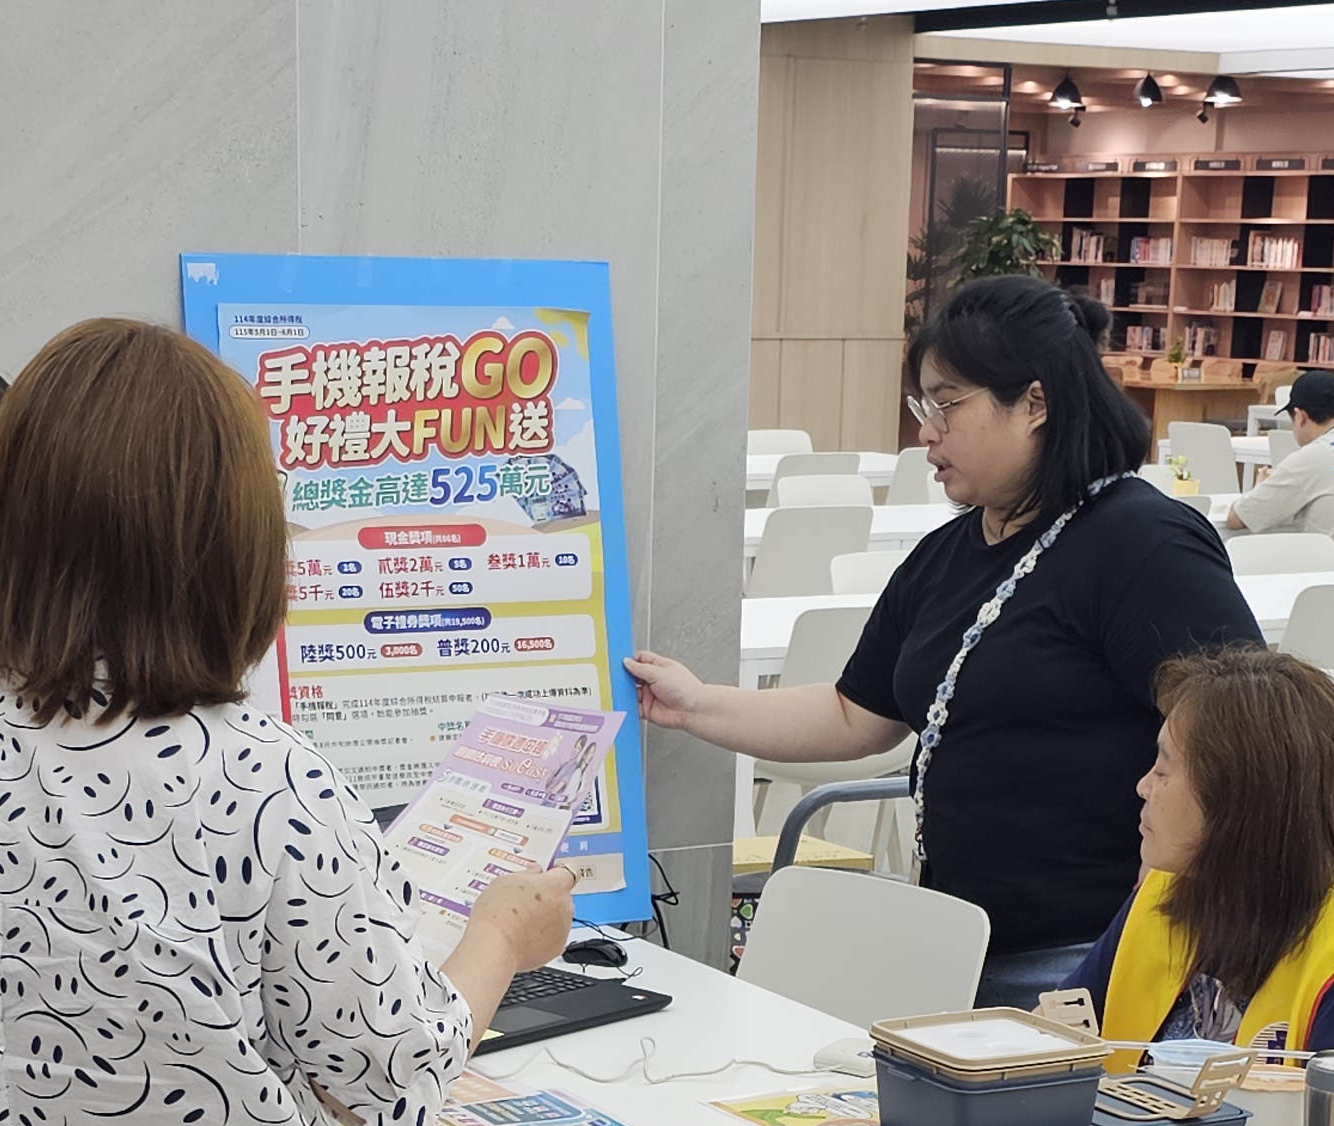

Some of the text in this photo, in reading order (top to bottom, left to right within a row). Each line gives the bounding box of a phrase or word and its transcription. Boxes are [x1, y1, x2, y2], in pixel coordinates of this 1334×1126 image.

[261, 336, 553, 414] 手機報稅GO
[285, 401, 550, 466] 好禮大FUN送
[292, 464, 551, 512] 總獎金高達525萬元
[377, 556, 444, 575] 貳獎2萬元
[342, 586, 361, 597] 20名
[379, 580, 471, 599] 伍獎2千元 50名
[300, 643, 377, 664] 陸獎500元
[437, 637, 511, 658] 普獎200元
